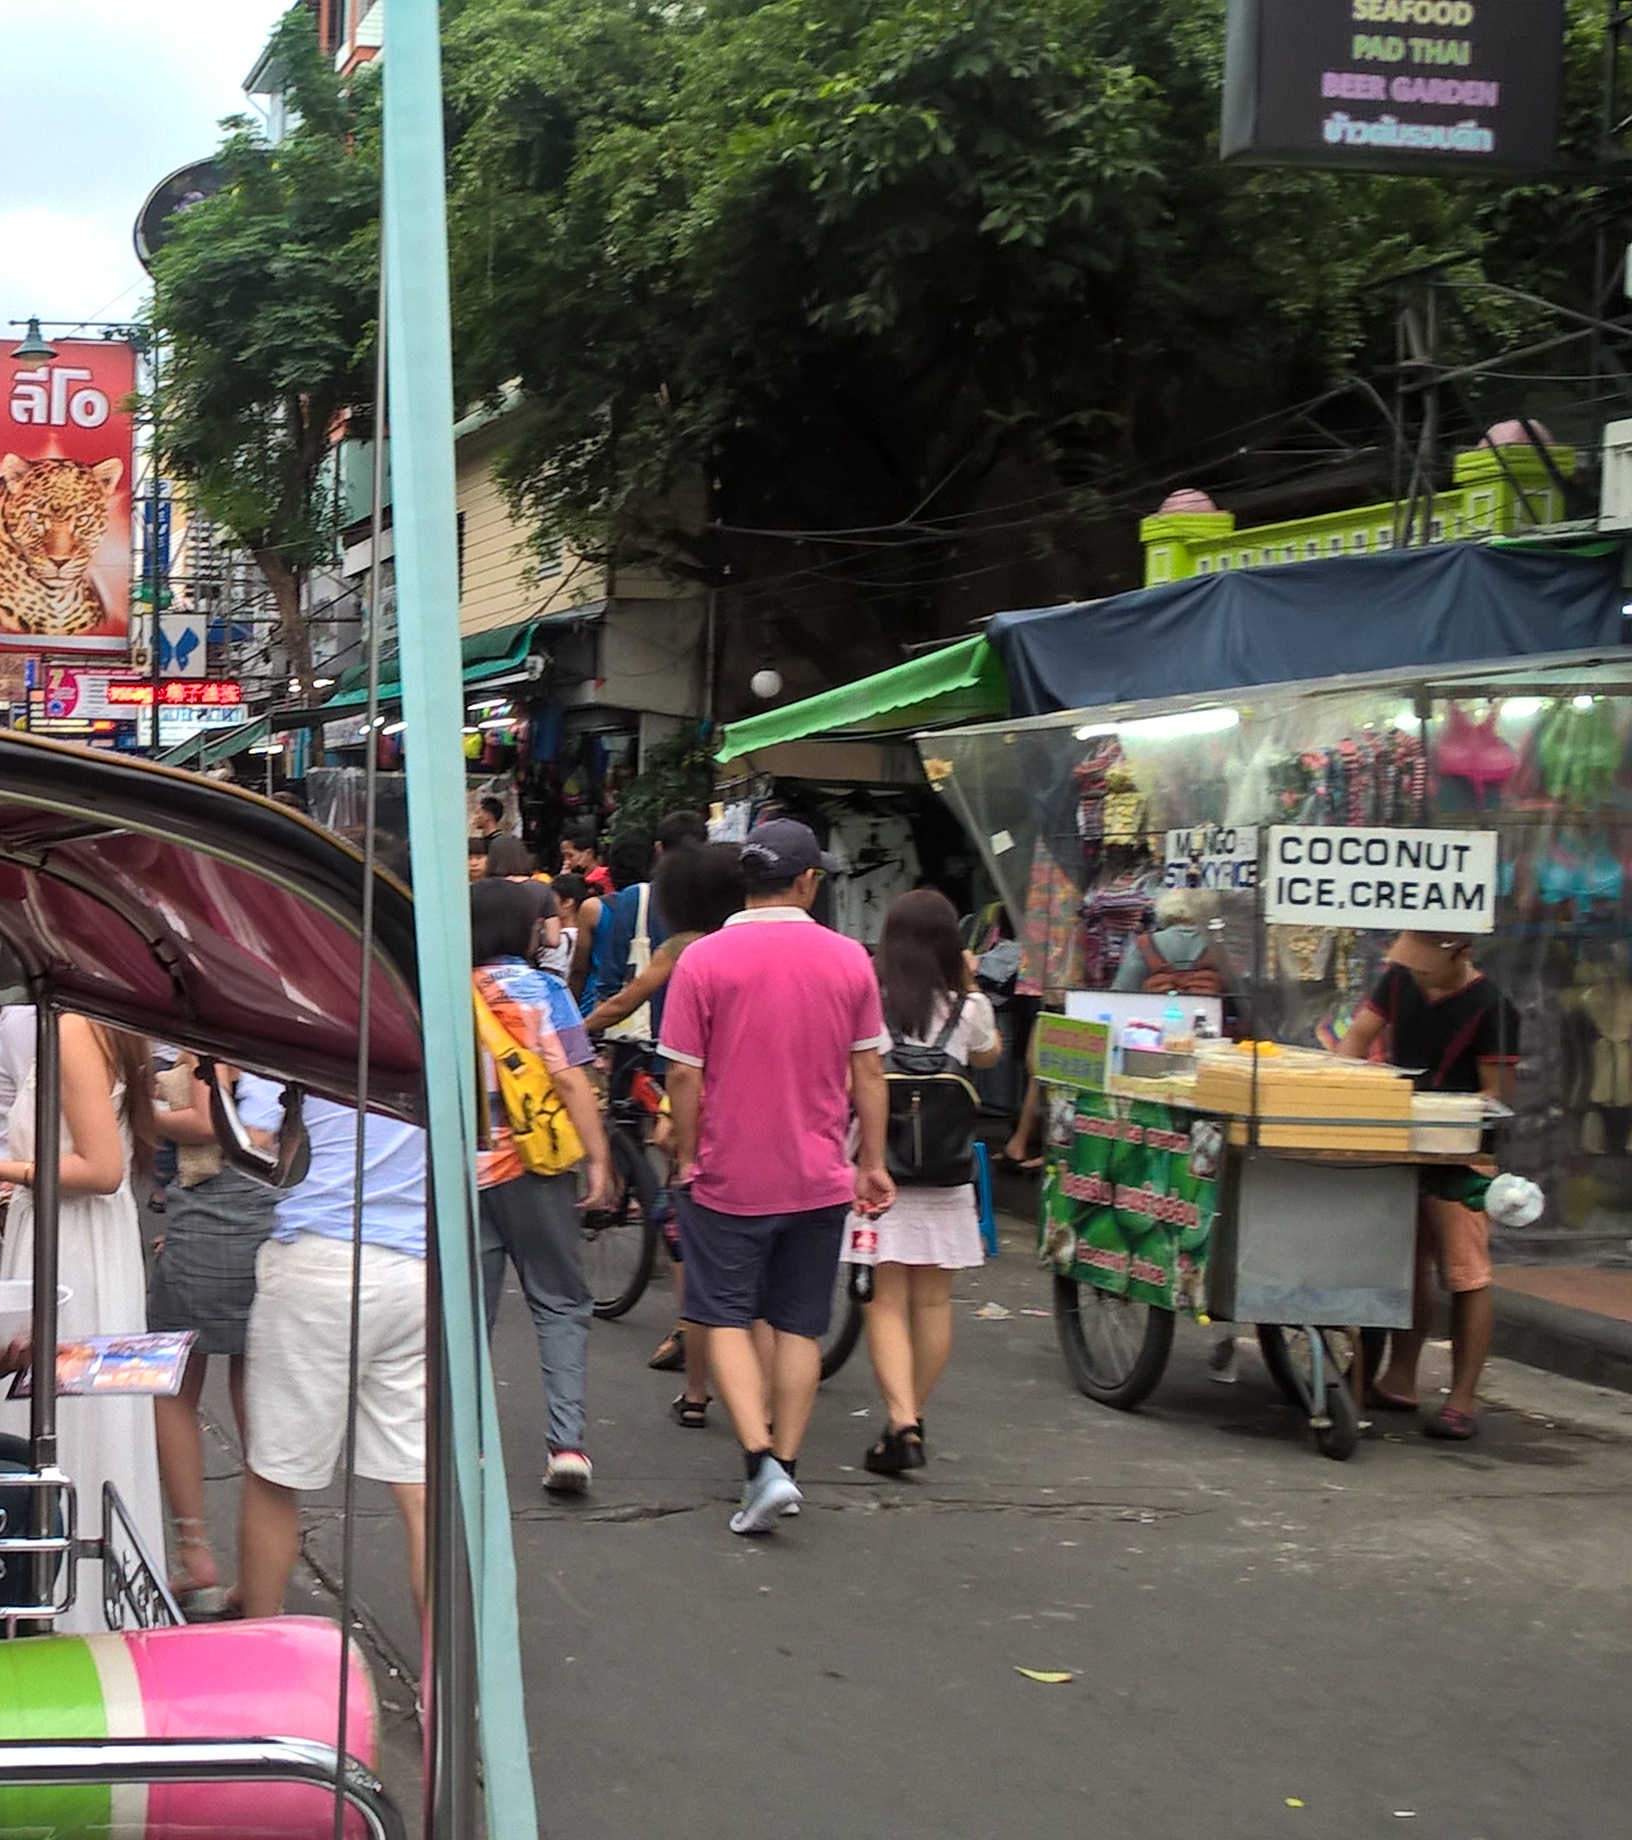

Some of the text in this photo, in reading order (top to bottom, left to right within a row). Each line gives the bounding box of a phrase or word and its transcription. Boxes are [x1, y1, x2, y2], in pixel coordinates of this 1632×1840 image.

[1352, 0, 1475, 27] SEAFOOD
[1352, 34, 1472, 66] PAD THAI
[1321, 71, 1500, 107] BEER GARDEN
[10, 365, 110, 429] ลีโอ
[1280, 836, 1471, 872] COCONUT
